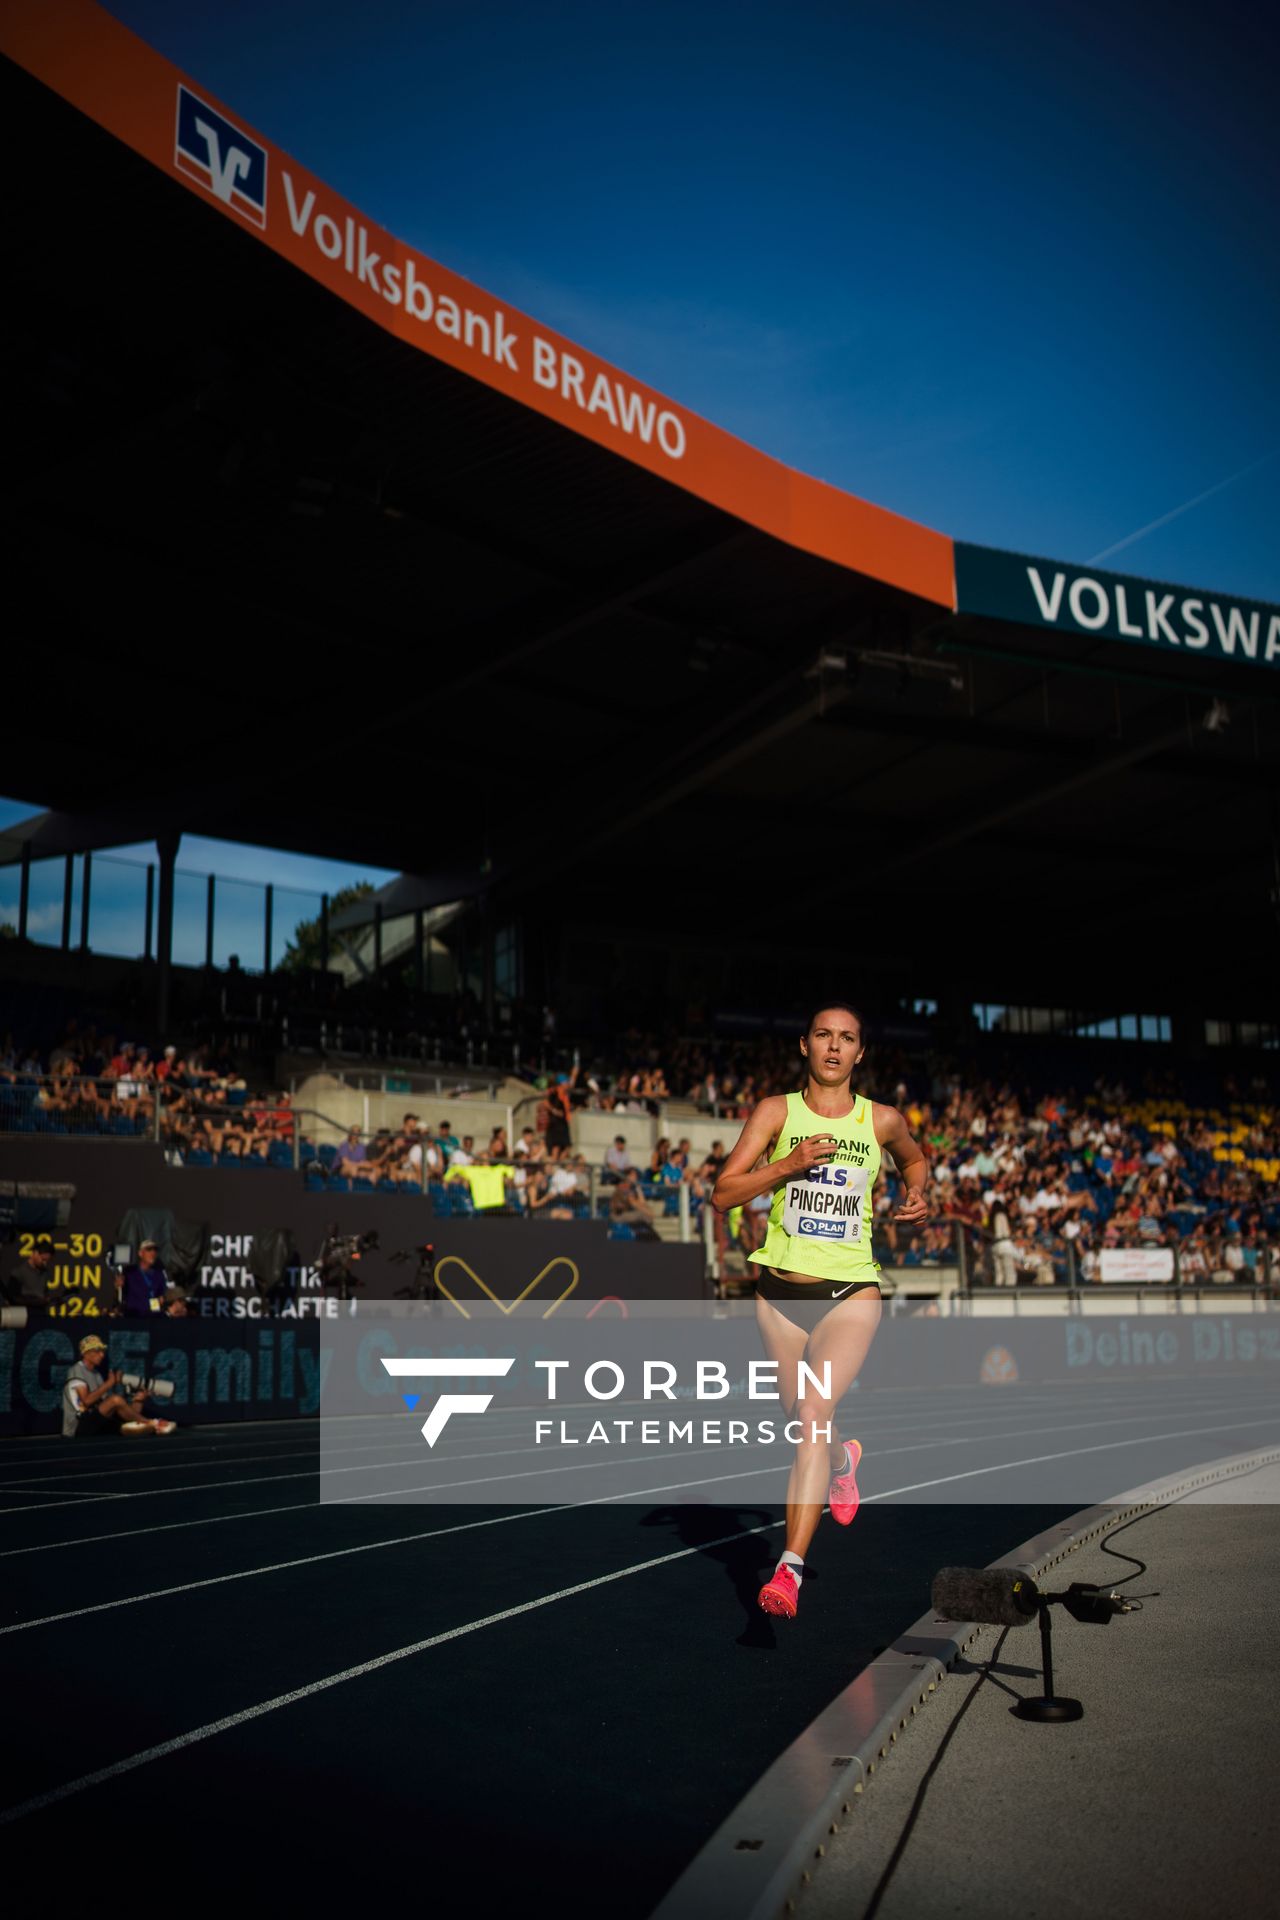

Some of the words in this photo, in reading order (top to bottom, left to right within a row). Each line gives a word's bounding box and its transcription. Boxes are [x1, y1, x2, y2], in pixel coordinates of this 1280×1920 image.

[281, 170, 519, 373] Volksbank
[532, 336, 687, 460] BRAWO
[804, 1166, 848, 1187] GLS
[790, 1187, 861, 1217] PINGPANK
[817, 1222, 845, 1233] PLAN
[47, 1264, 102, 1290] JUN
[1065, 1320, 1178, 1367] Deine
[105, 1328, 332, 1414] Family
